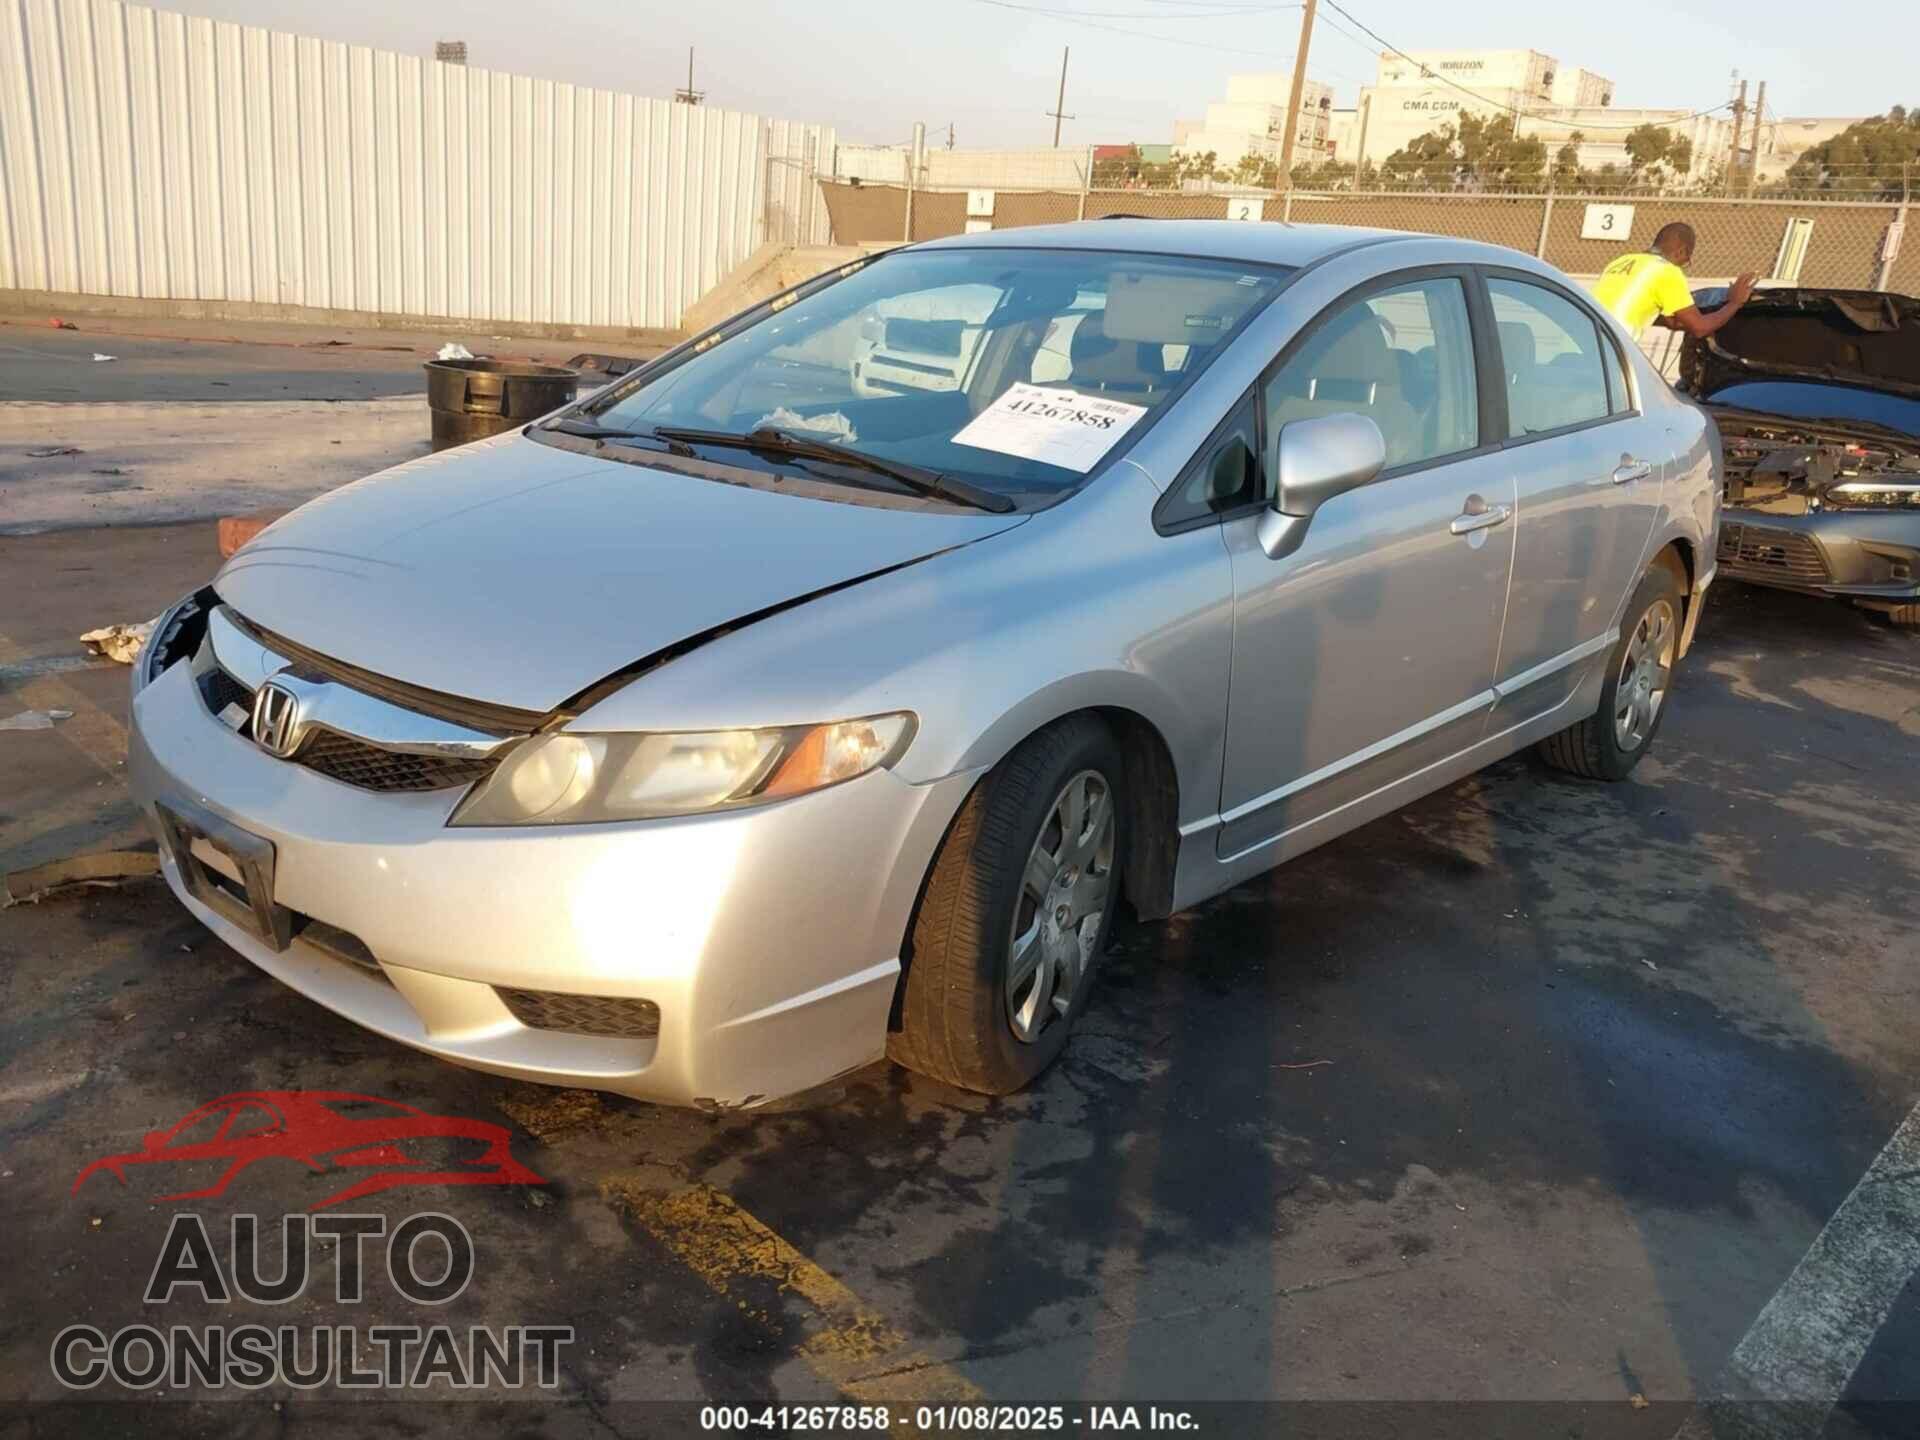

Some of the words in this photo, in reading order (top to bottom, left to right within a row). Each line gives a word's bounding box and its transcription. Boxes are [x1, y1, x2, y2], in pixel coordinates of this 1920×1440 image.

[1403, 101, 1429, 110] CMA
[1432, 101, 1460, 110] CGM
[1240, 206, 1249, 220] 2
[1601, 213, 1614, 231] 3
[1008, 400, 1116, 430] 41267858
